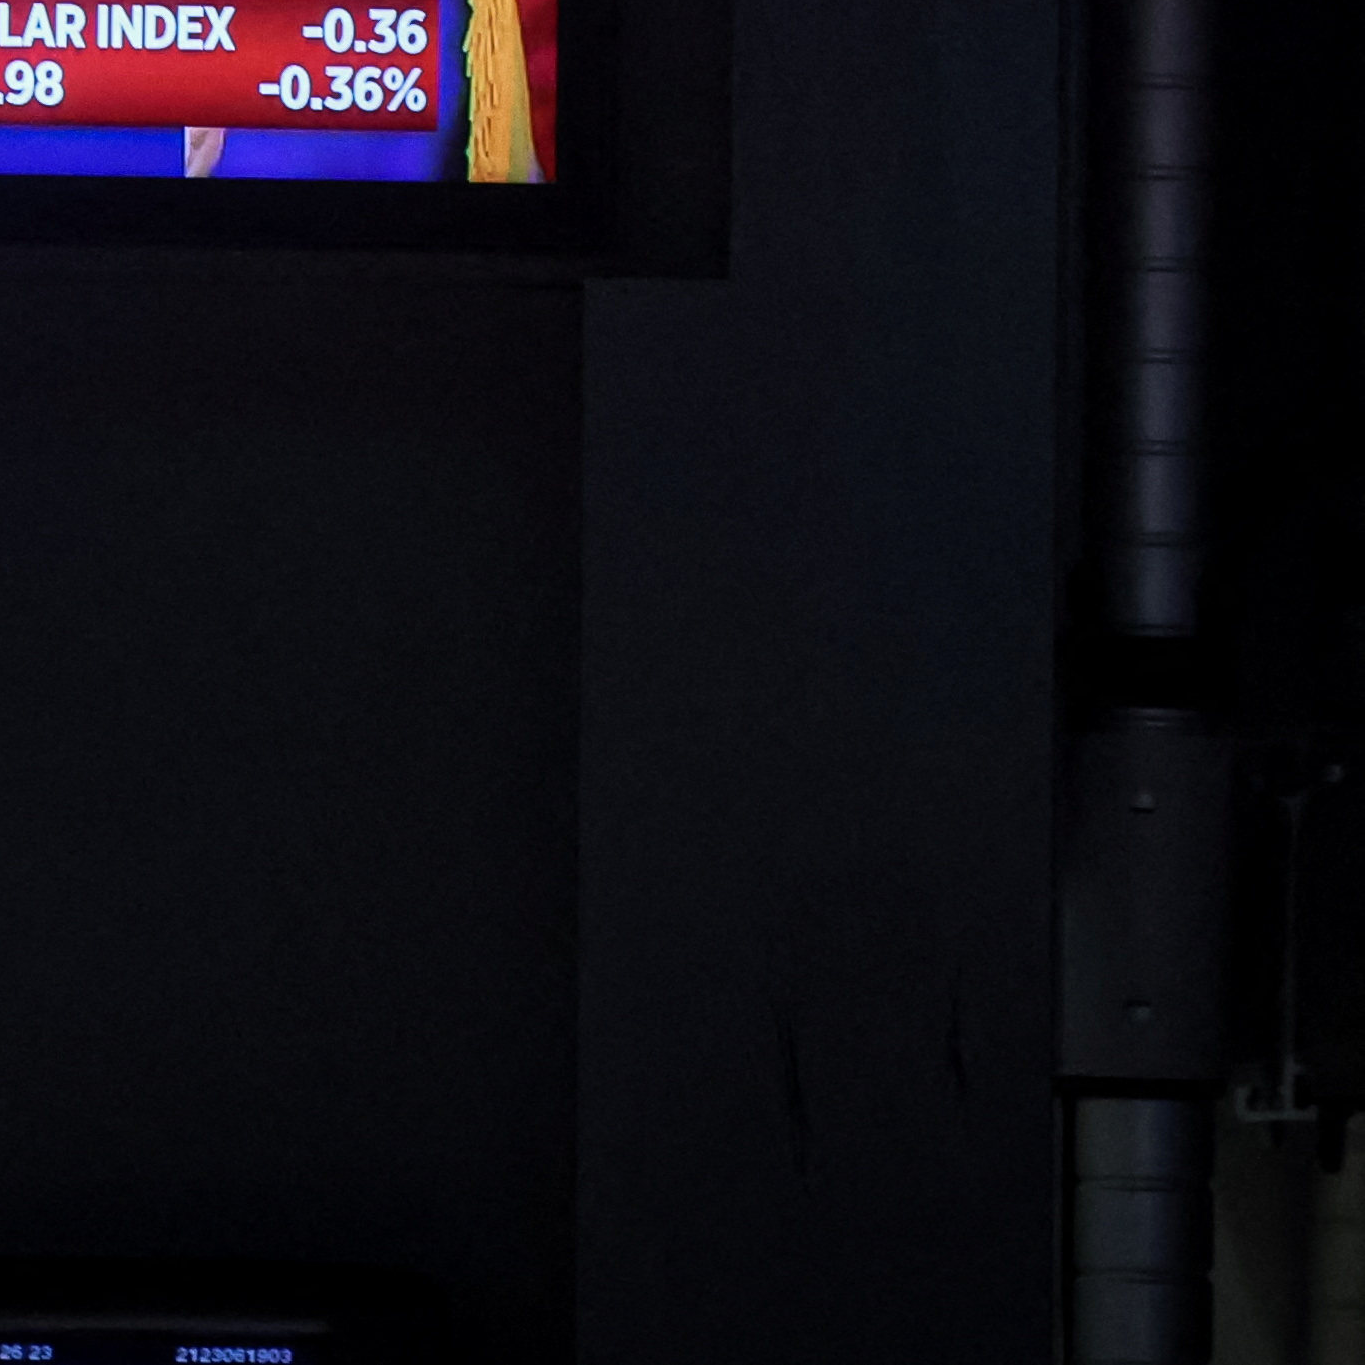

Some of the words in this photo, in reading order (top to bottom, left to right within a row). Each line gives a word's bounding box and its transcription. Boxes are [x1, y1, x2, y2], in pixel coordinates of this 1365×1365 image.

[96, 4, 236, 51] INDEX
[302, 8, 428, 55] -0.36
[258, 67, 427, 112] -0.36%
